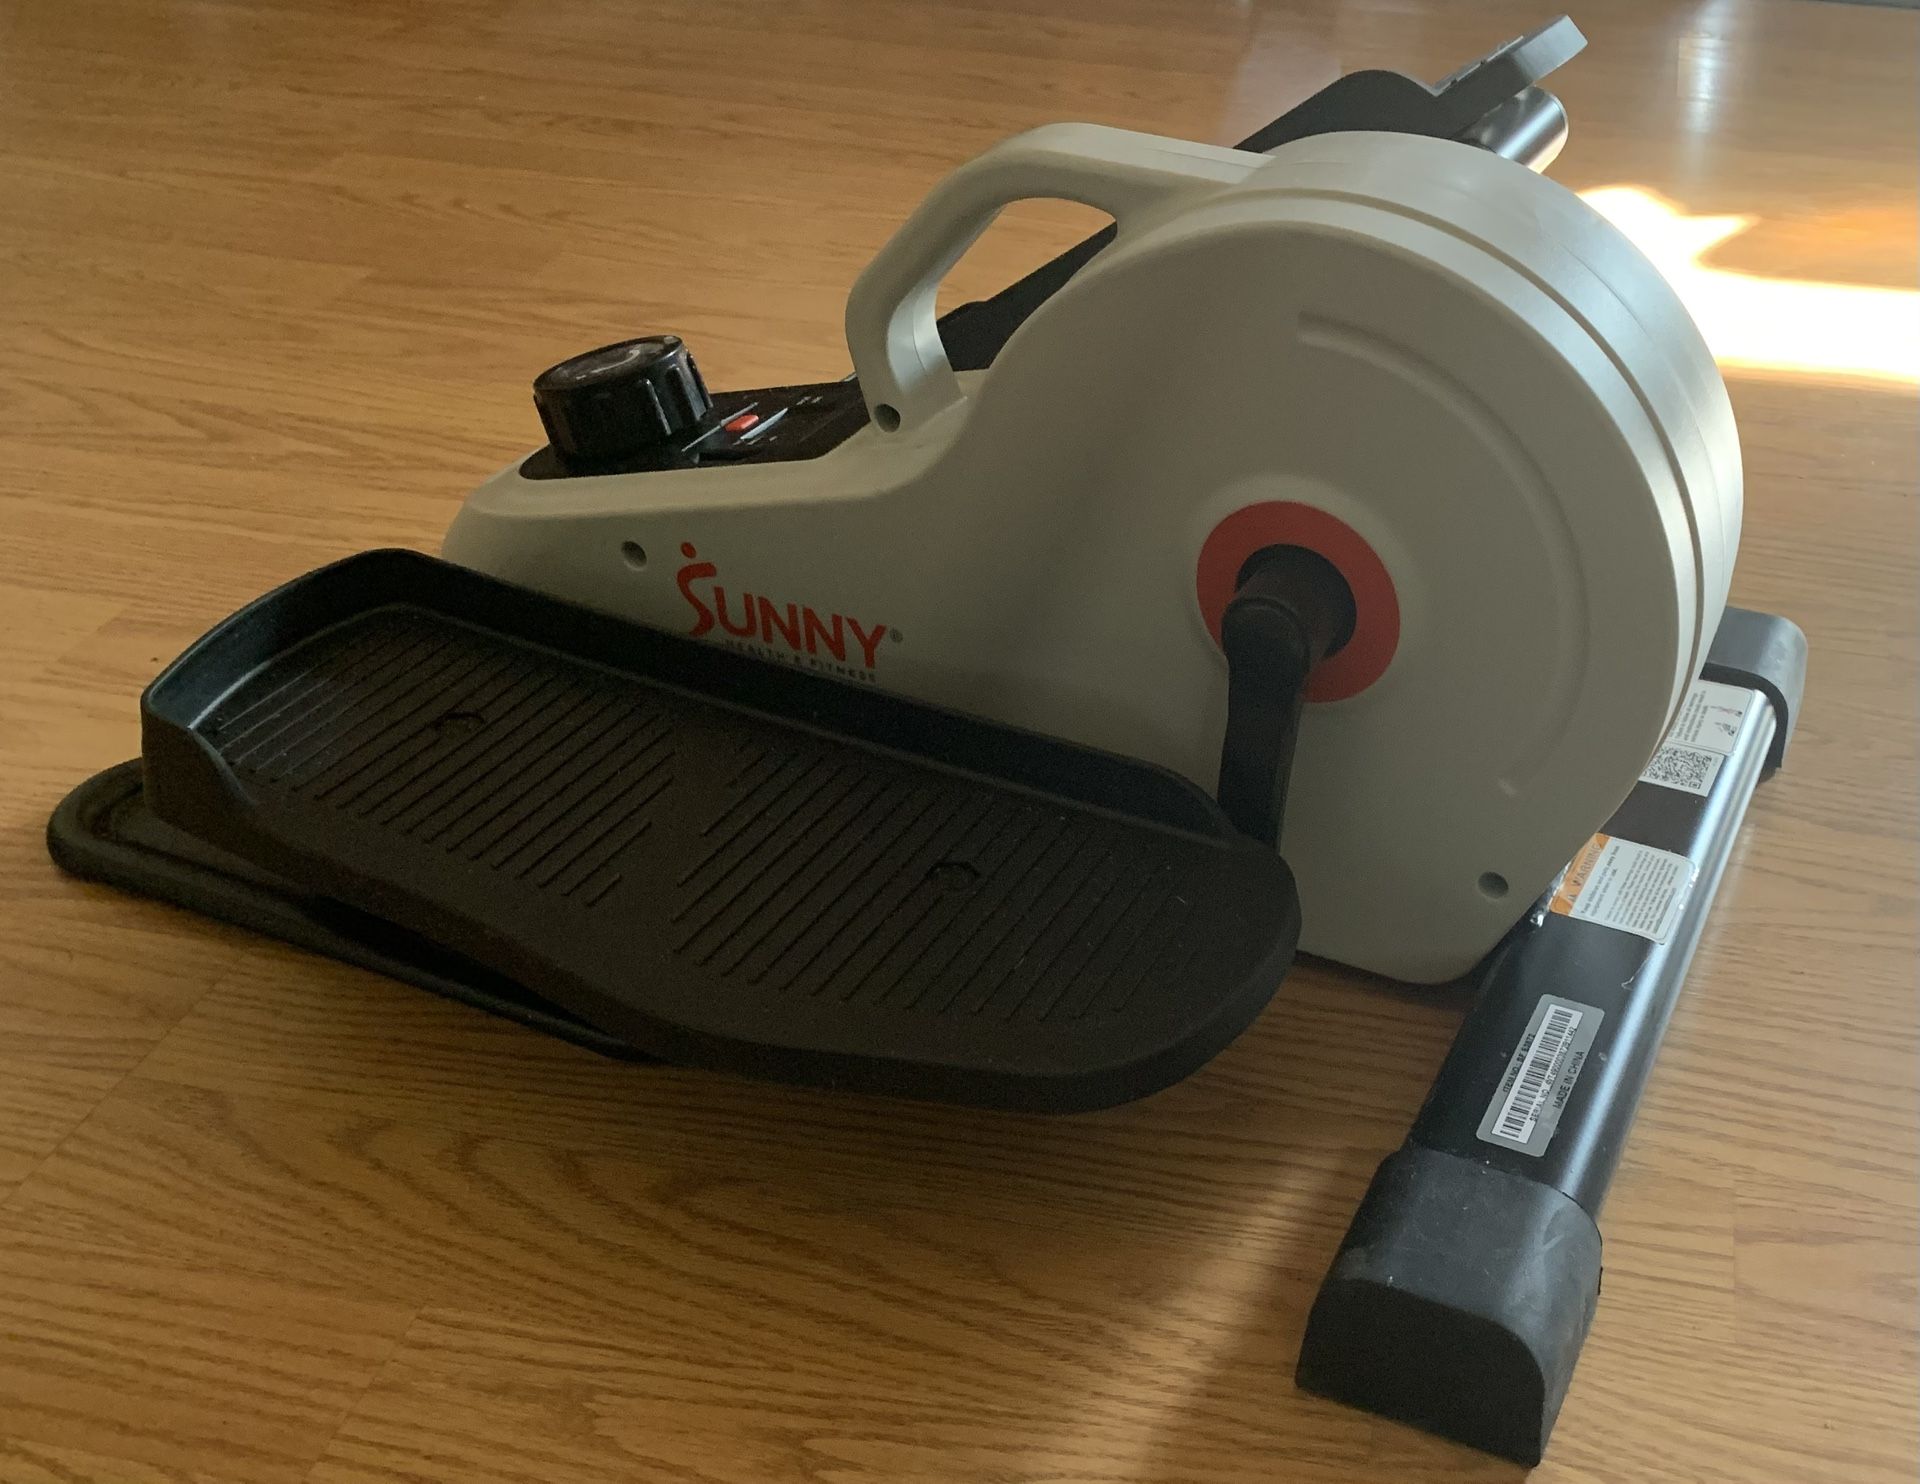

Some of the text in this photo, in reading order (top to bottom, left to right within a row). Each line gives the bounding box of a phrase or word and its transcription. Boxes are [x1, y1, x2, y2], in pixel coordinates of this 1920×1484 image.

[677, 542, 887, 668] SUNNY
[809, 657, 878, 684] FITNESS
[1567, 1050, 1585, 1074] CHINA
[1564, 1074, 1576, 1086] IN
[1552, 1085, 1571, 1109] MADE
